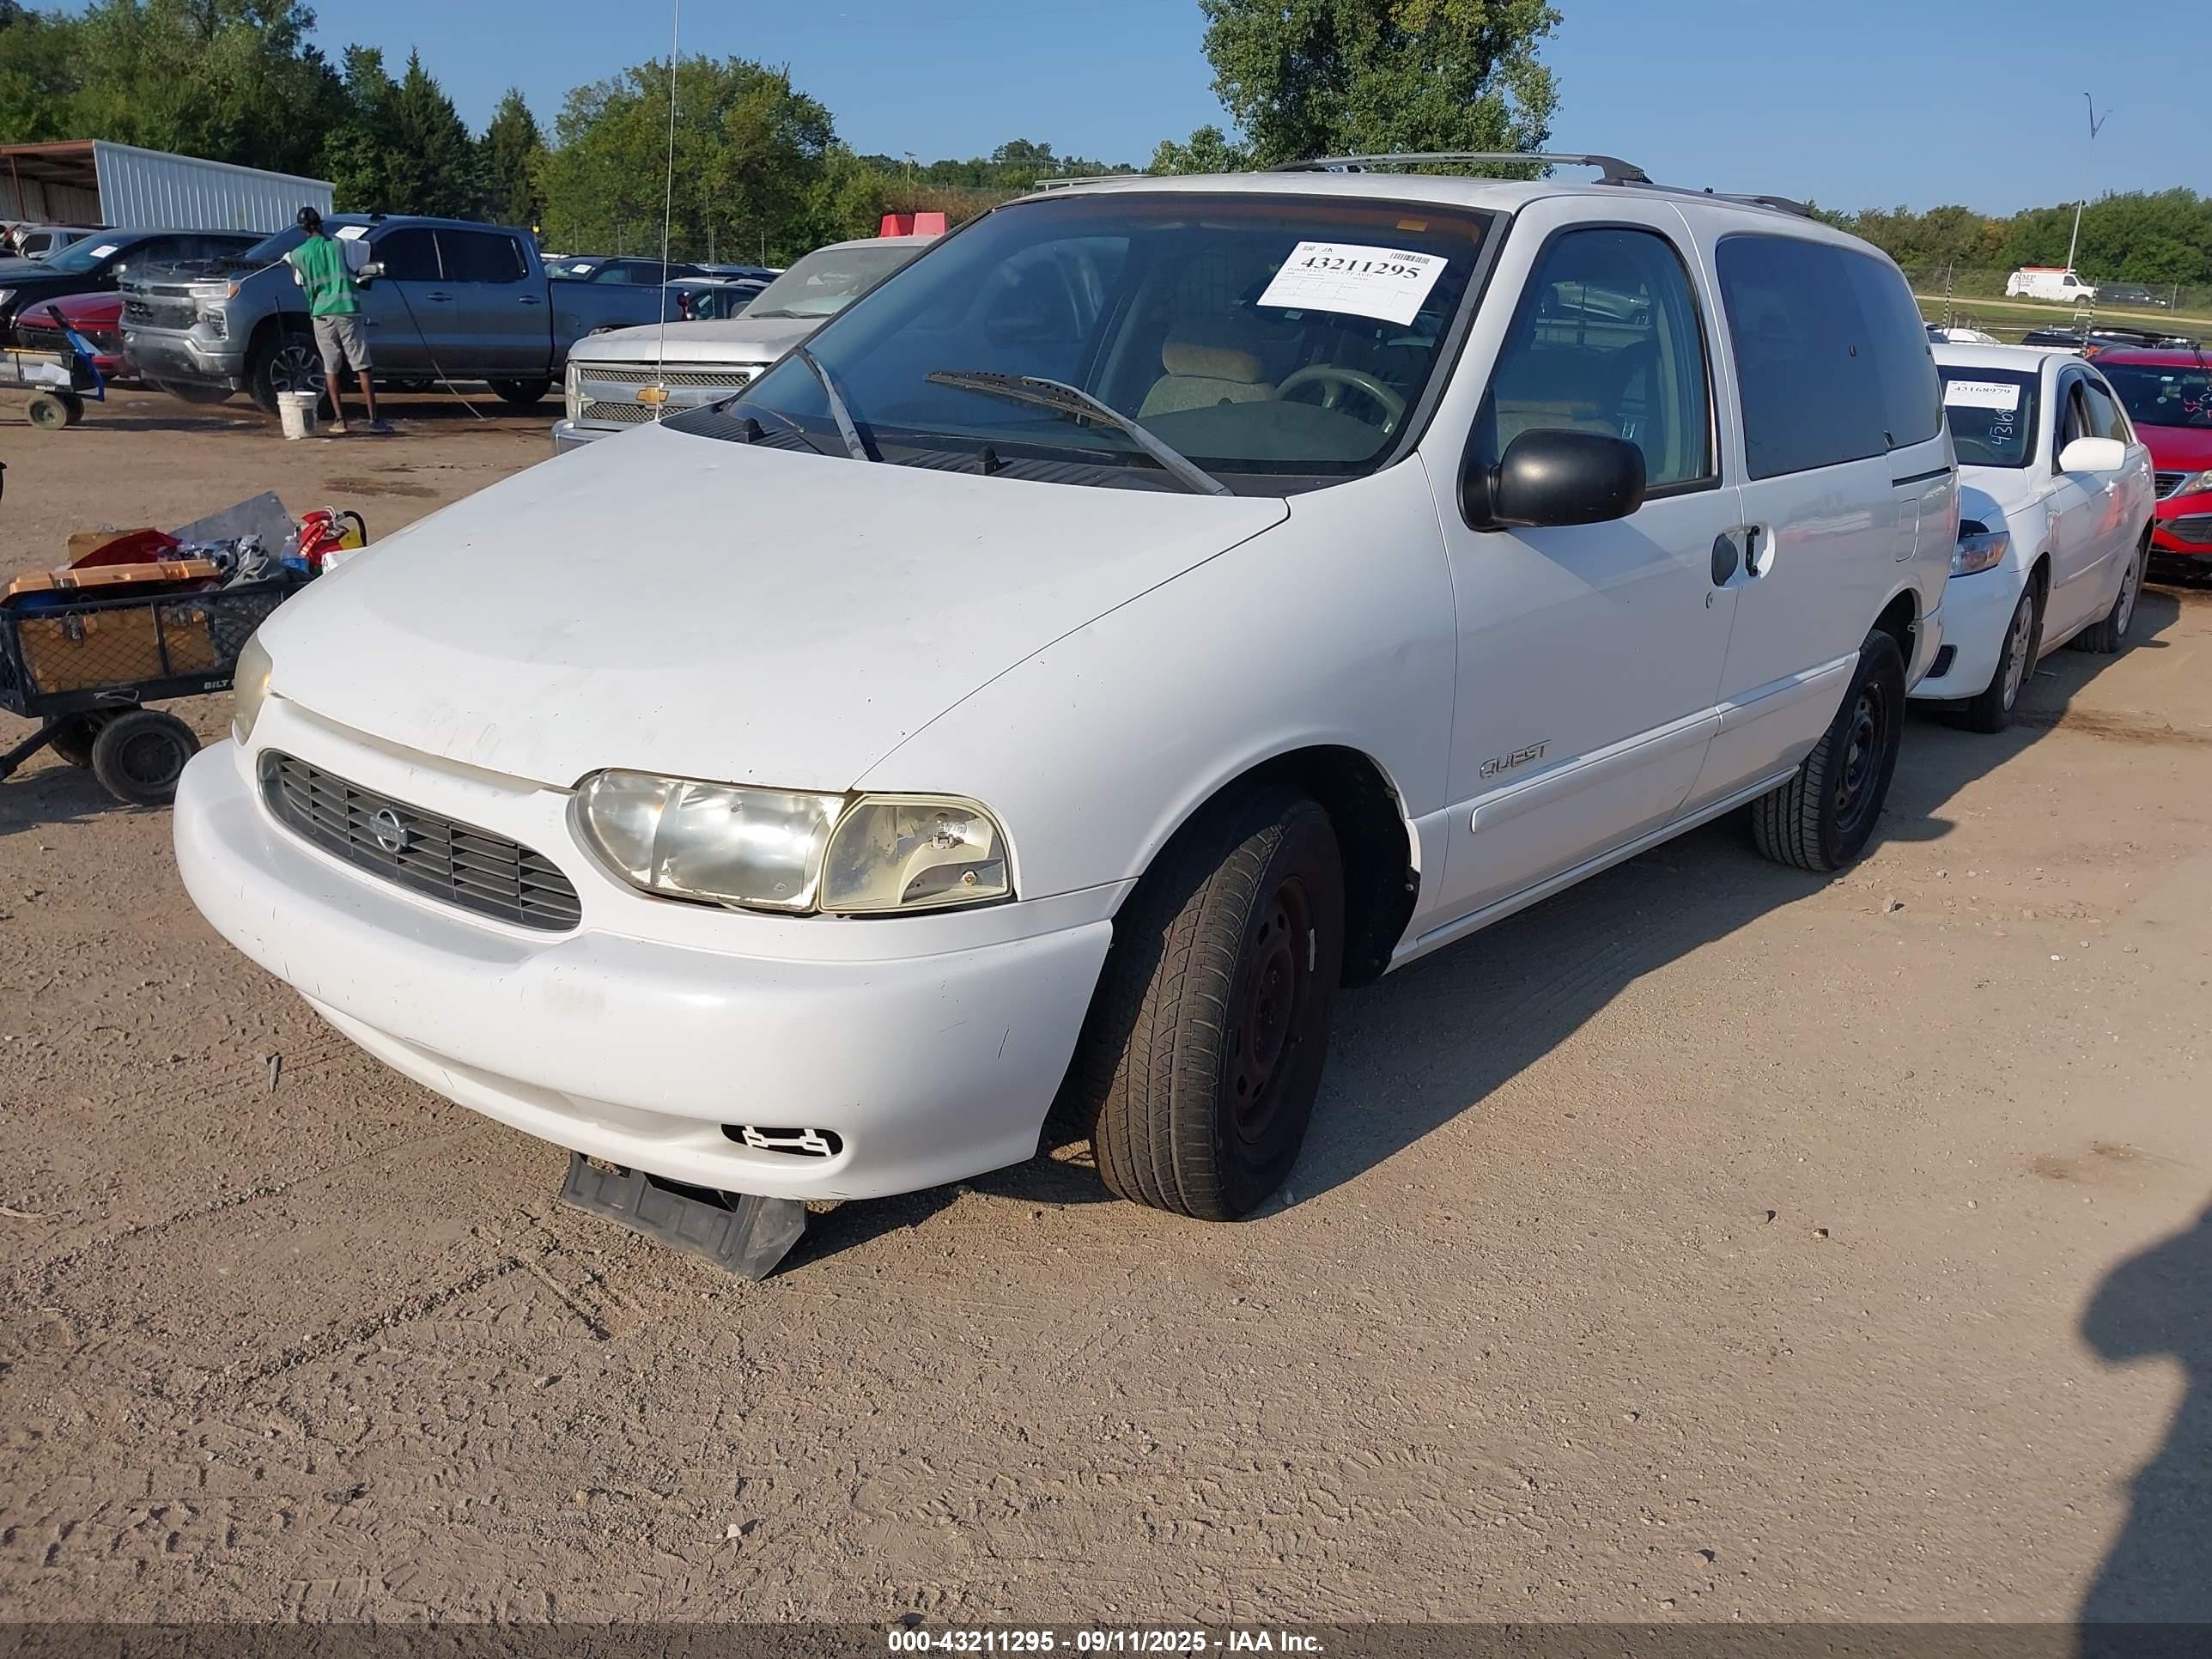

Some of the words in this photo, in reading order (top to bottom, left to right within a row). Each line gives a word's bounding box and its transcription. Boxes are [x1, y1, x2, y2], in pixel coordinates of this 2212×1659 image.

[1300, 256, 1422, 280] 43211295
[204, 679, 228, 690] BILT
[1480, 738, 1553, 779] QUEST
